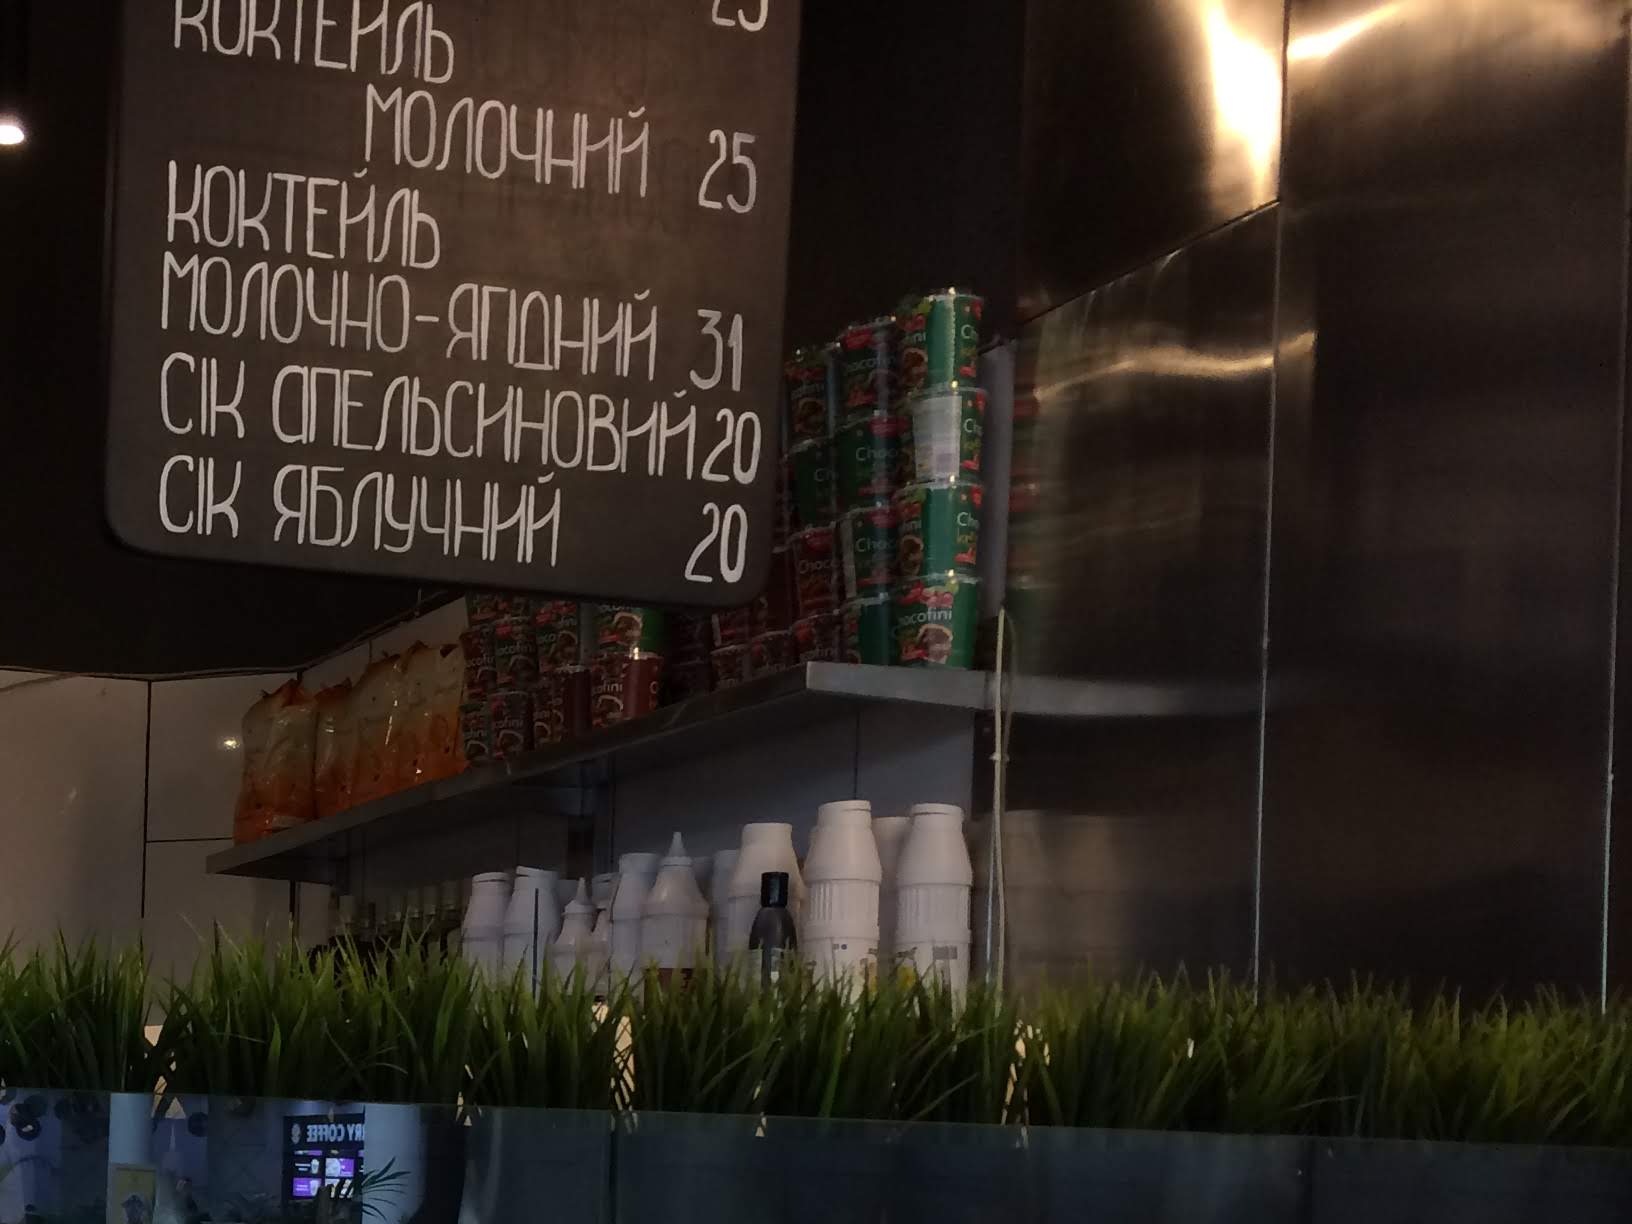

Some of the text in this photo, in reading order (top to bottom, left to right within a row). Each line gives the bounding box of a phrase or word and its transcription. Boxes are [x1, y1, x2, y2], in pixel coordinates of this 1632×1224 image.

[365, 83, 756, 213] МОЛОЧНИЙ 25
[168, 160, 440, 269] КОКТЕЙЛЬ
[162, 251, 742, 391] МОЛОЧНО-ЯГІДНИЙ 31
[272, 365, 696, 480] АПЕЛЬСИНОВИЙ
[701, 408, 761, 484] 20
[274, 464, 560, 567] ЯБЛУЧНИЙ
[685, 502, 748, 583] 20
